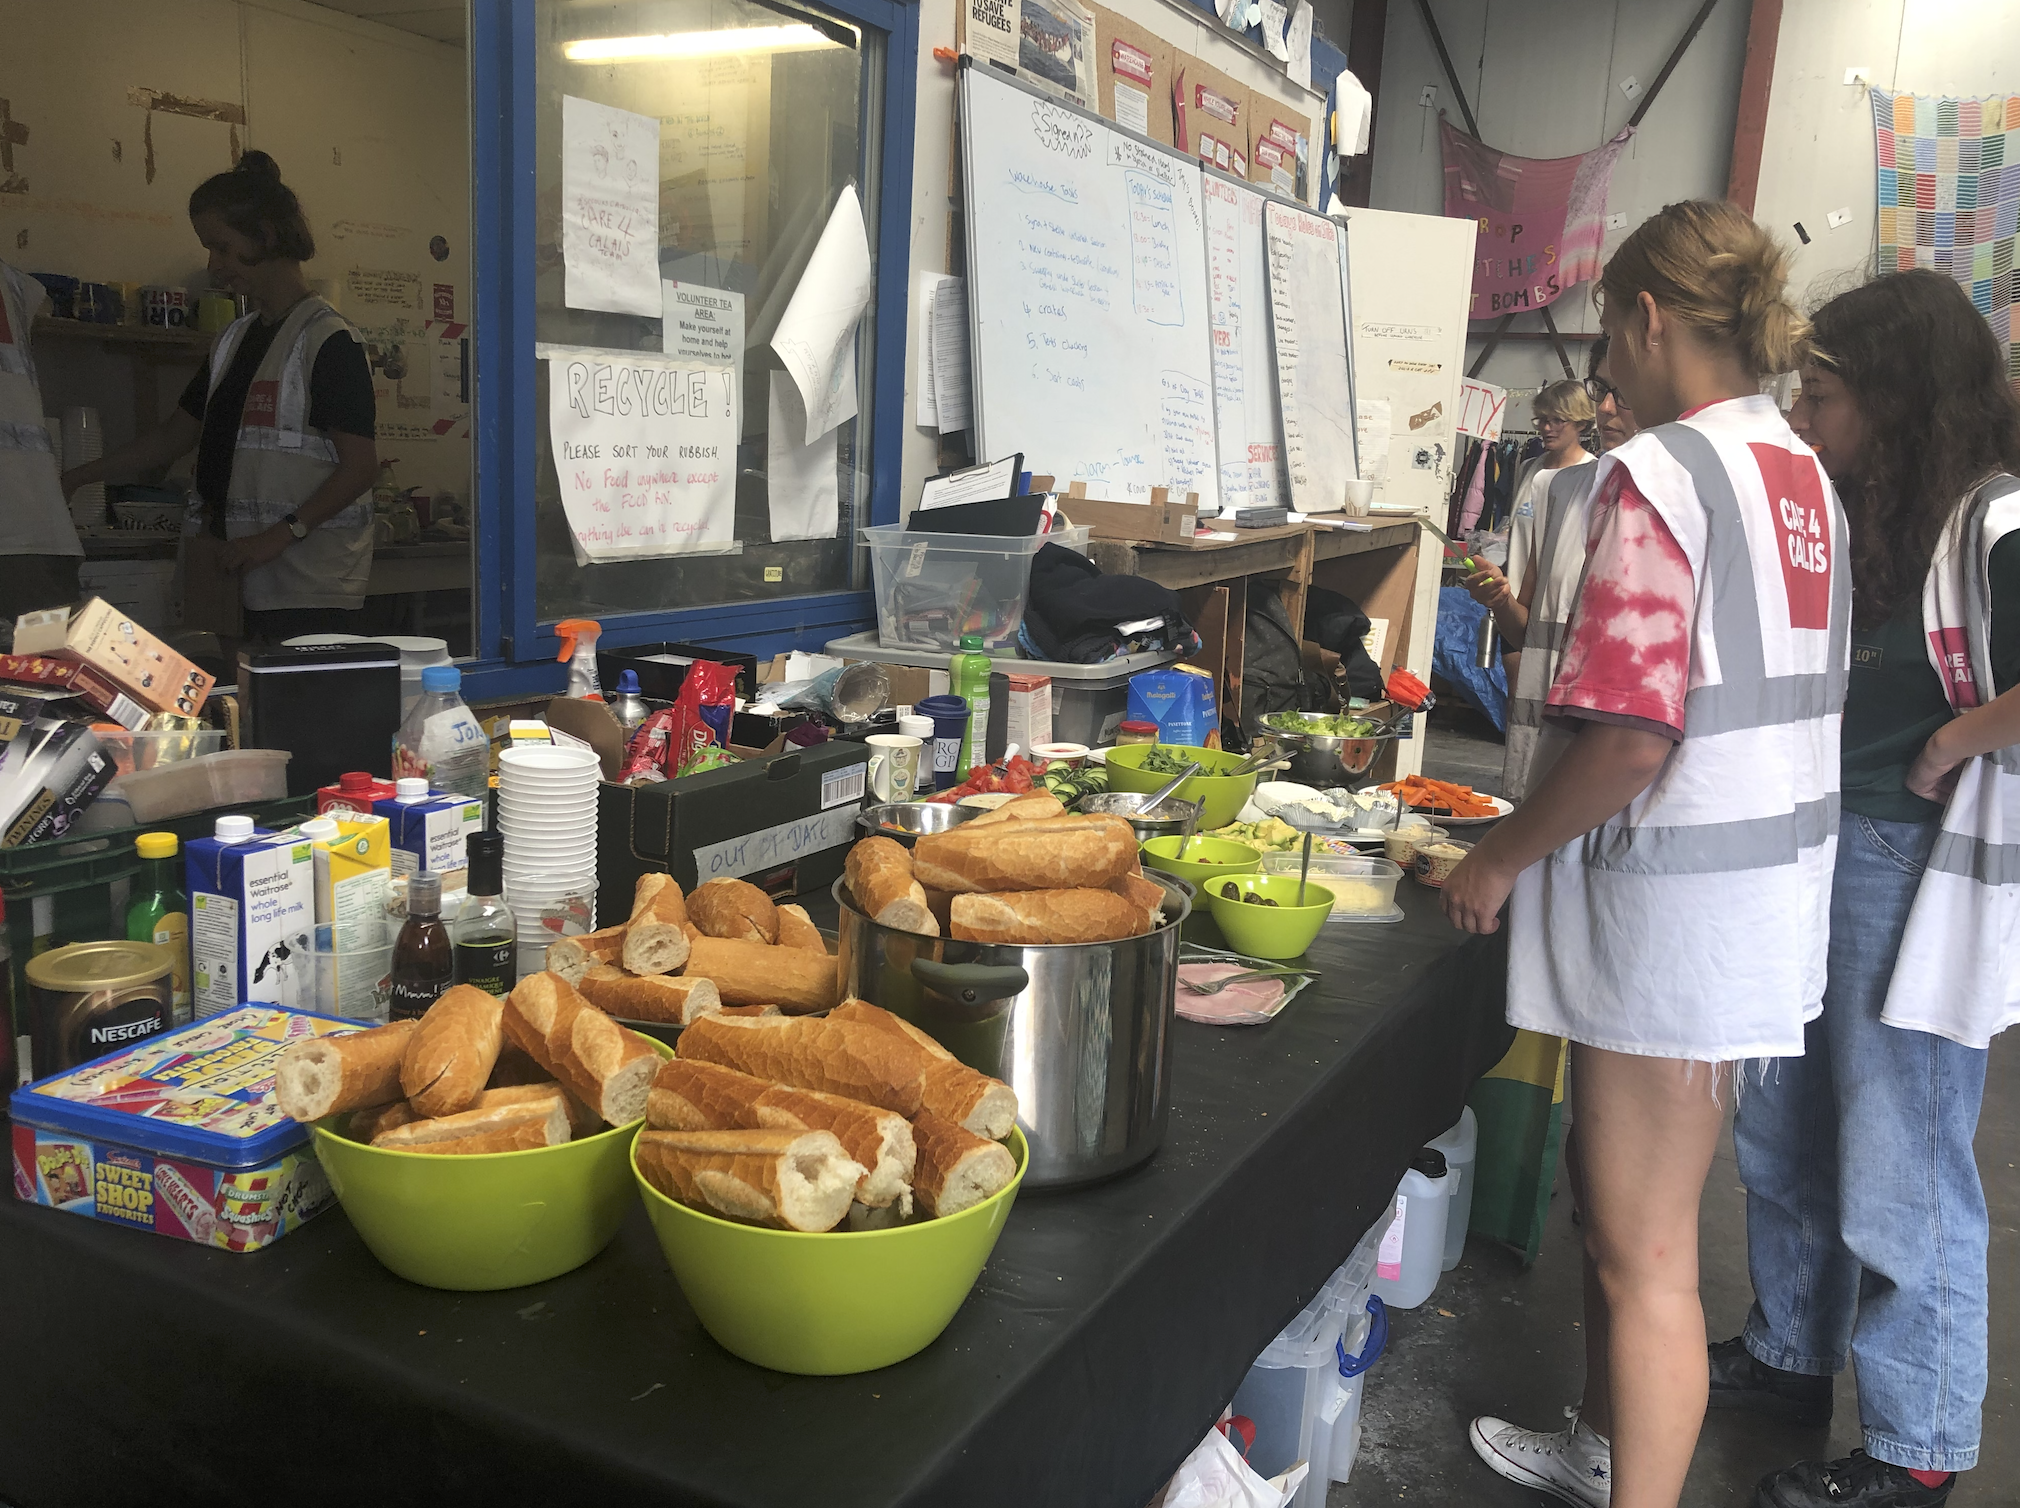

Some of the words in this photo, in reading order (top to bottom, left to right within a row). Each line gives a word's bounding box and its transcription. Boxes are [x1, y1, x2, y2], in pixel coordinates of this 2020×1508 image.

[984, 0, 1004, 17] SAVE
[972, 6, 1012, 33] REFUGEES
[581, 204, 614, 230] CARE
[617, 215, 636, 240] 4
[588, 233, 632, 257] CALAIS
[676, 291, 717, 309] VOLUNTEER
[717, 299, 733, 311] TEA
[1491, 275, 1560, 312] BOMBS
[695, 308, 716, 321] AREA:
[679, 320, 696, 333] Make
[697, 324, 723, 338] yourself
[724, 328, 732, 336] at
[682, 334, 699, 346] home
[701, 336, 713, 346] and
[715, 337, 728, 351] help
[567, 361, 709, 419] RECYCLE
[721, 372, 732, 418] !
[563, 441, 601, 461] PLEASE
[613, 445, 638, 460] SORT
[645, 445, 669, 460] YOUR
[679, 445, 720, 461] RUBBISH.
[574, 470, 592, 491] No
[603, 468, 629, 489] Food
[687, 470, 719, 486] except
[592, 496, 611, 513] the
[639, 523, 655, 536] can
[1809, 508, 1821, 539] 4
[937, 742, 959, 755] RC
[935, 755, 956, 768] GP
[6, 797, 51, 846] TWININGS
[33, 811, 54, 838] GREY
[430, 828, 459, 843] essential
[430, 837, 462, 852] Waitrose
[710, 840, 750, 873] OUT
[787, 817, 828, 851] DATE
[430, 853, 450, 865] whole
[249, 870, 289, 888] essential
[250, 881, 293, 898] Waitrose
[250, 898, 278, 911] whole
[251, 911, 272, 925] long
[273, 907, 287, 919] life
[288, 902, 304, 914] milk
[151, 1036, 262, 1082] FAVOURITES
[96, 1162, 153, 1190] SWEET
[96, 1181, 154, 1213] SHOP
[156, 1167, 172, 1190] LOVE
[166, 1180, 200, 1221] HEARTS
[276, 1180, 292, 1215] HOT
[97, 1203, 154, 1225] FAVOURITES
[222, 1205, 273, 1225] Squashies
